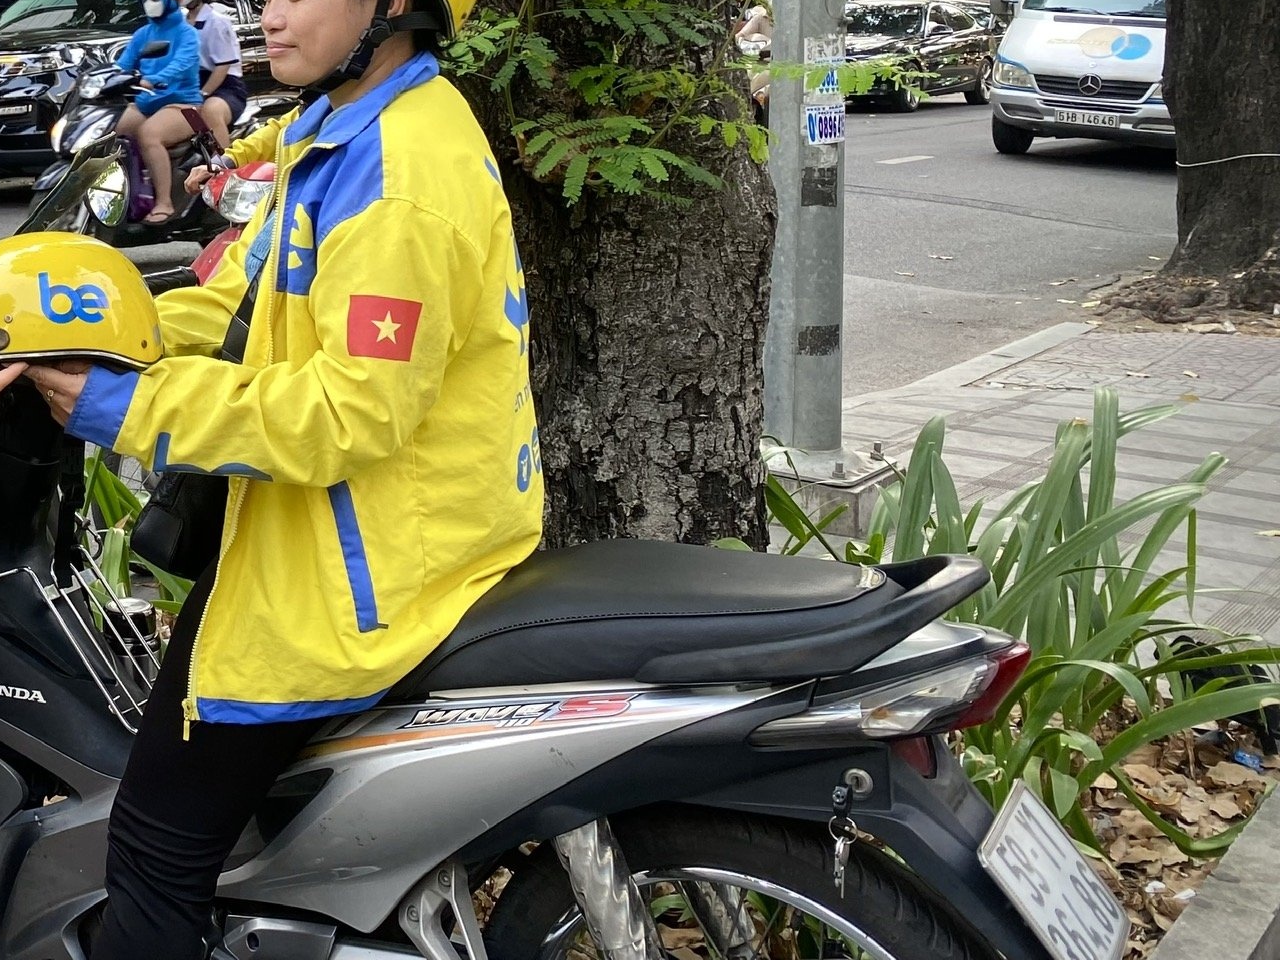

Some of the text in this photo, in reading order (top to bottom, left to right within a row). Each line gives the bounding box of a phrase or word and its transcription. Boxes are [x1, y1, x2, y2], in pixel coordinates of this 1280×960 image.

[37, 270, 110, 325] be
[544, 692, 634, 721] S
[995, 802, 1067, 908] 59-Y1
